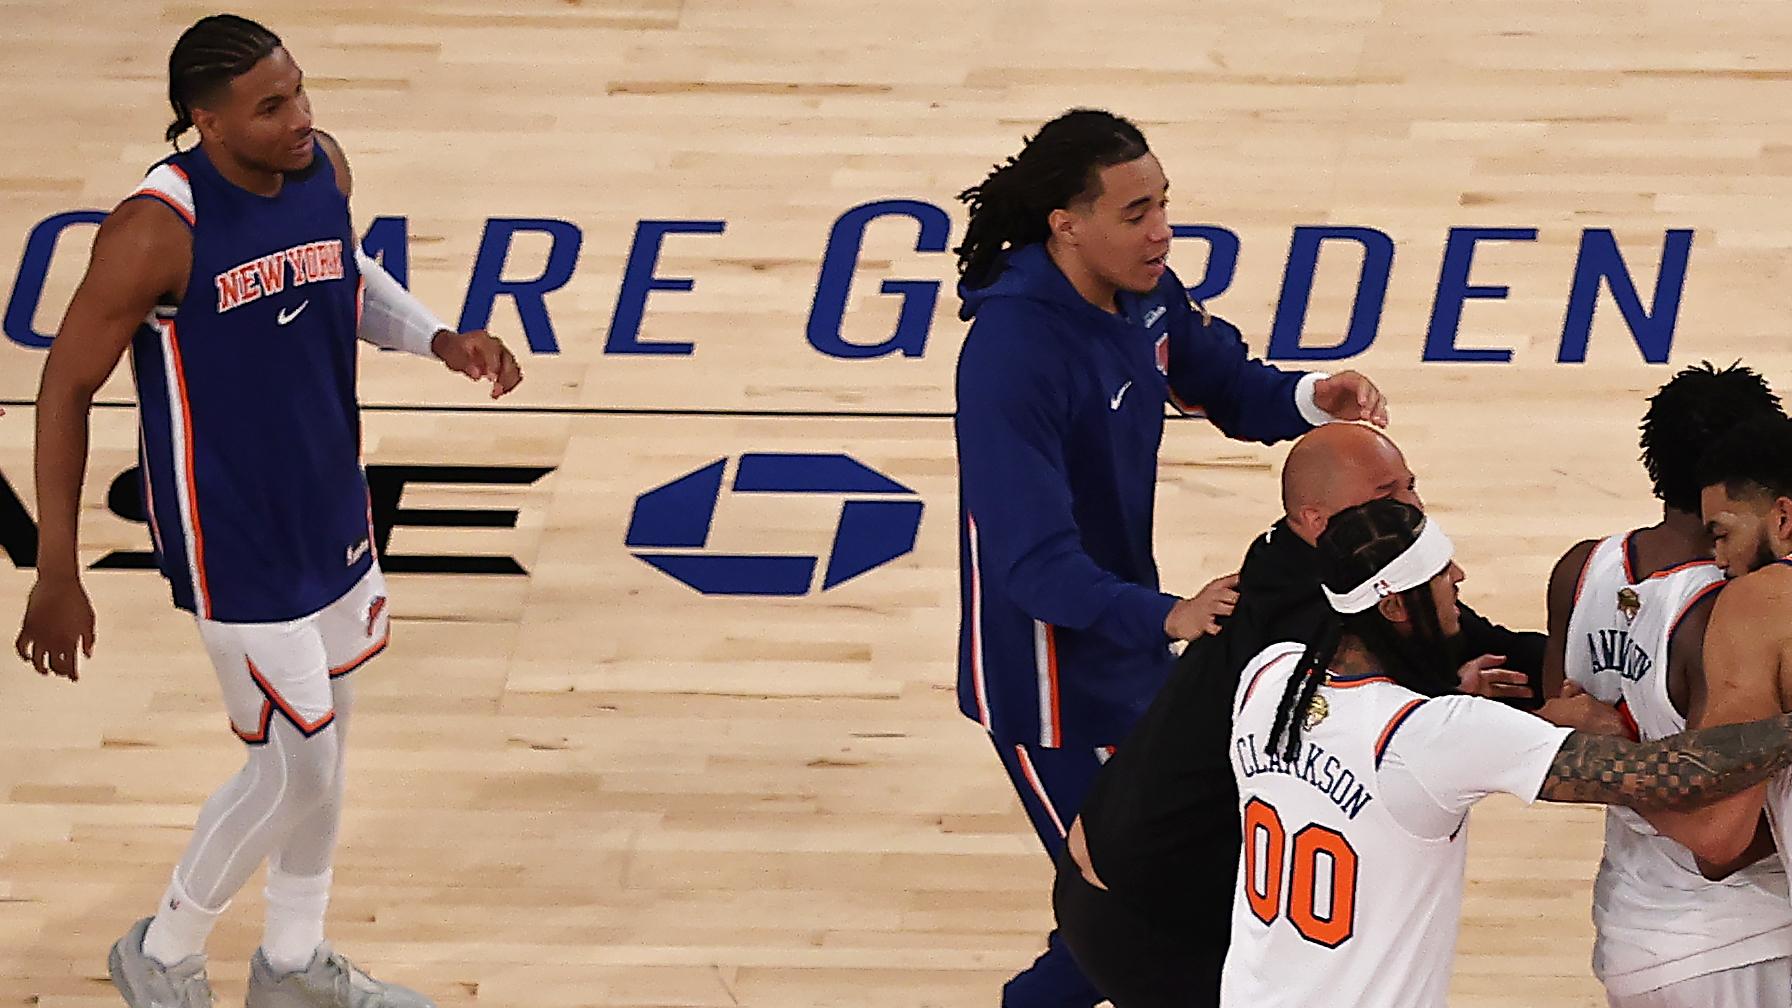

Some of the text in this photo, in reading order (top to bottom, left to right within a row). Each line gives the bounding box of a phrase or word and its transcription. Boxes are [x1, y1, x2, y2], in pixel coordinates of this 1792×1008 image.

[214, 250, 287, 313] NEW
[806, 200, 1694, 363] GDEN
[1243, 795, 1359, 949] 00
